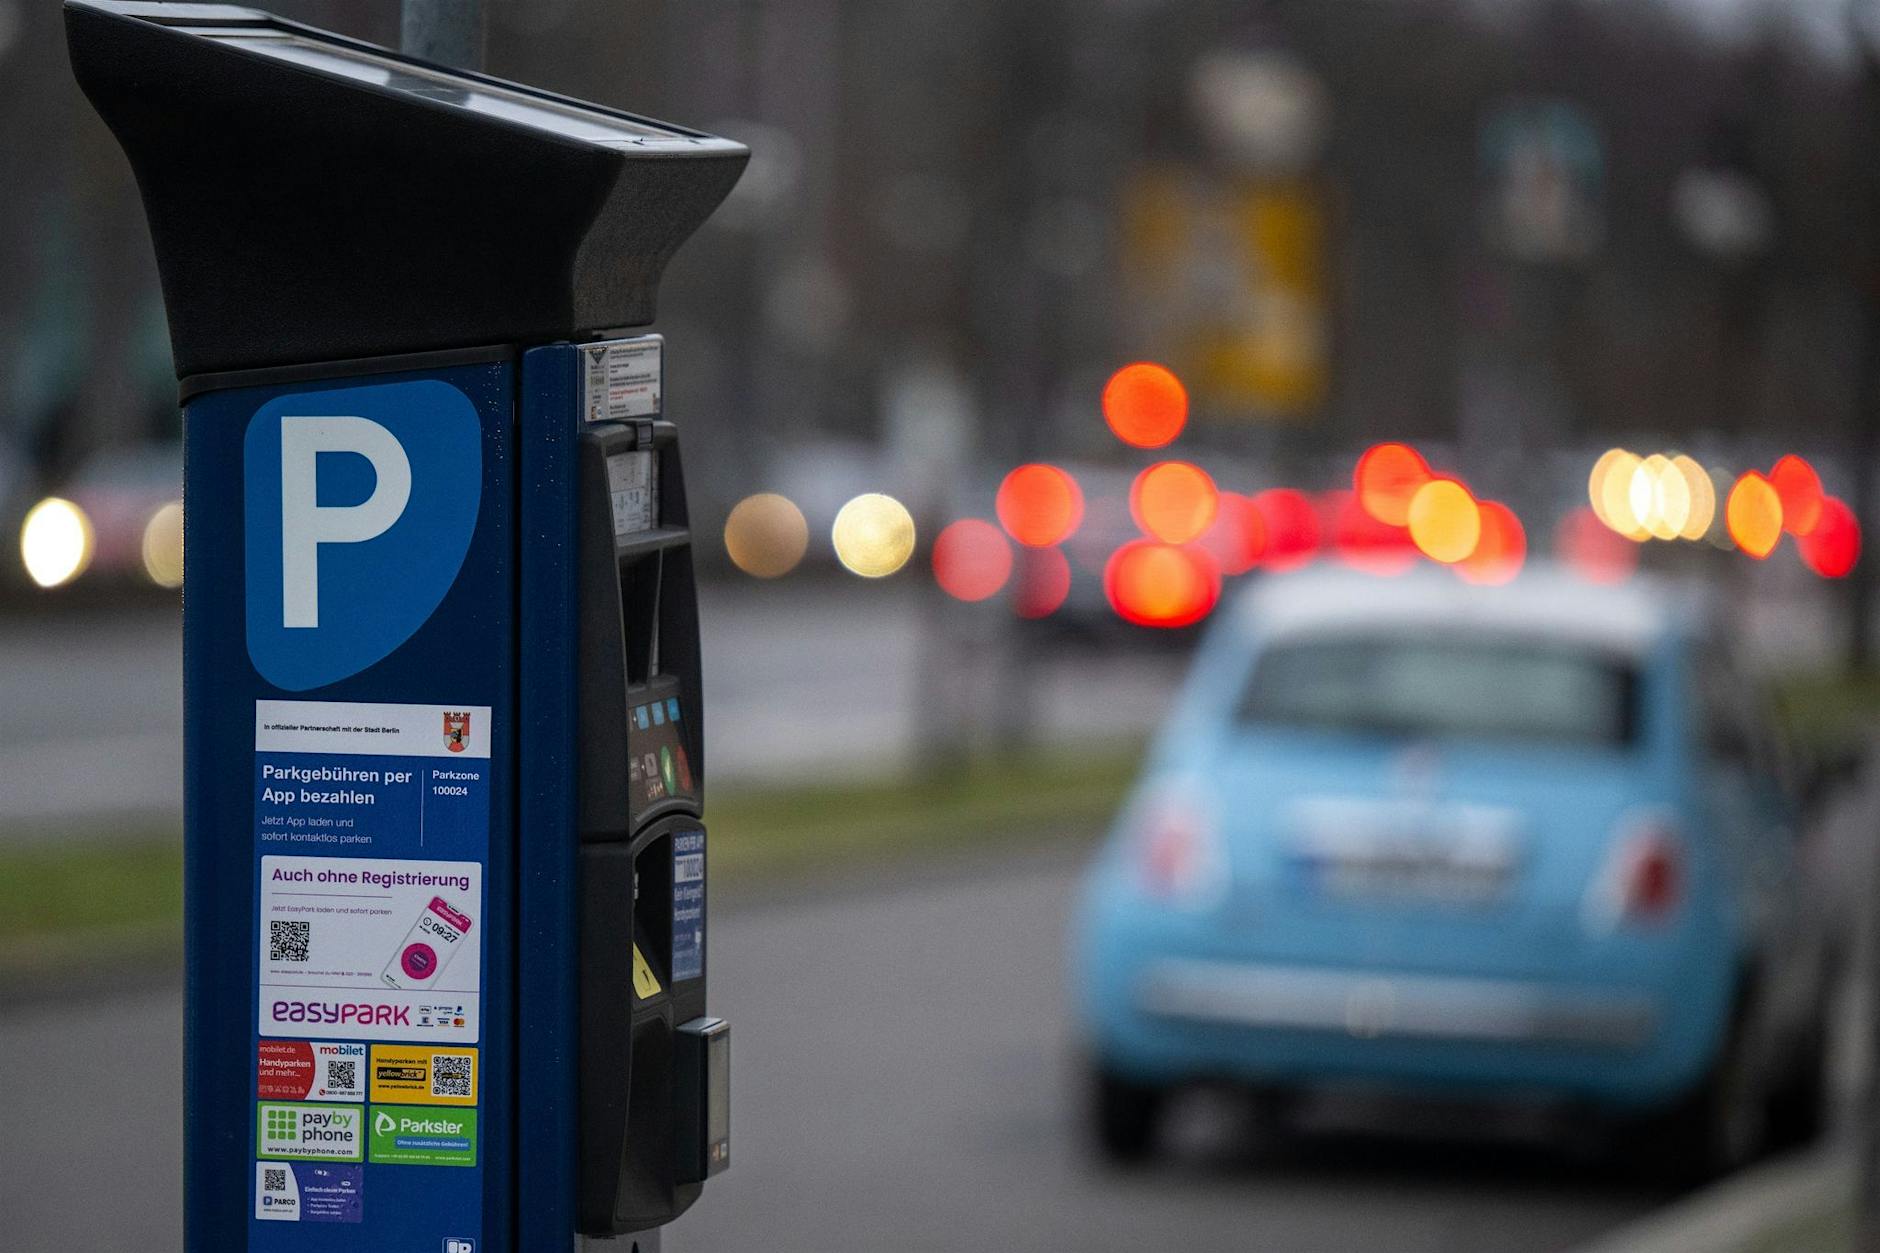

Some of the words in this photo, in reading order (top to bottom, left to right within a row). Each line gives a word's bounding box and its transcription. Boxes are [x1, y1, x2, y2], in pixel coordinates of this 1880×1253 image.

[281, 416, 412, 628] P
[263, 765, 379, 784] Parkgebühren
[384, 770, 412, 785] per
[432, 770, 480, 781] Parkzone
[262, 788, 295, 805] App
[301, 789, 374, 804] bezahlen
[433, 786, 468, 796] 100024
[262, 816, 284, 825] Jetzt
[287, 816, 305, 827] App
[308, 817, 333, 826] laden
[336, 818, 353, 827] und
[262, 832, 288, 841] sofort
[290, 833, 338, 843] kontaktlos
[340, 834, 372, 844] parken
[272, 868, 313, 882] Auch
[318, 871, 357, 883] ohne
[362, 872, 470, 891] Registrierung
[287, 906, 315, 914] EasyPark
[432, 923, 458, 943] 09:27
[259, 1045, 296, 1054] mobilet.de
[320, 1045, 364, 1055] mobilet
[259, 1059, 311, 1068] Handyparken
[378, 1070, 417, 1079] yellowbrick
[303, 1111, 352, 1127] payby
[401, 1118, 463, 1134] Parkster
[302, 1127, 353, 1143] phone
[267, 1146, 353, 1156] www.paybyphone.com
